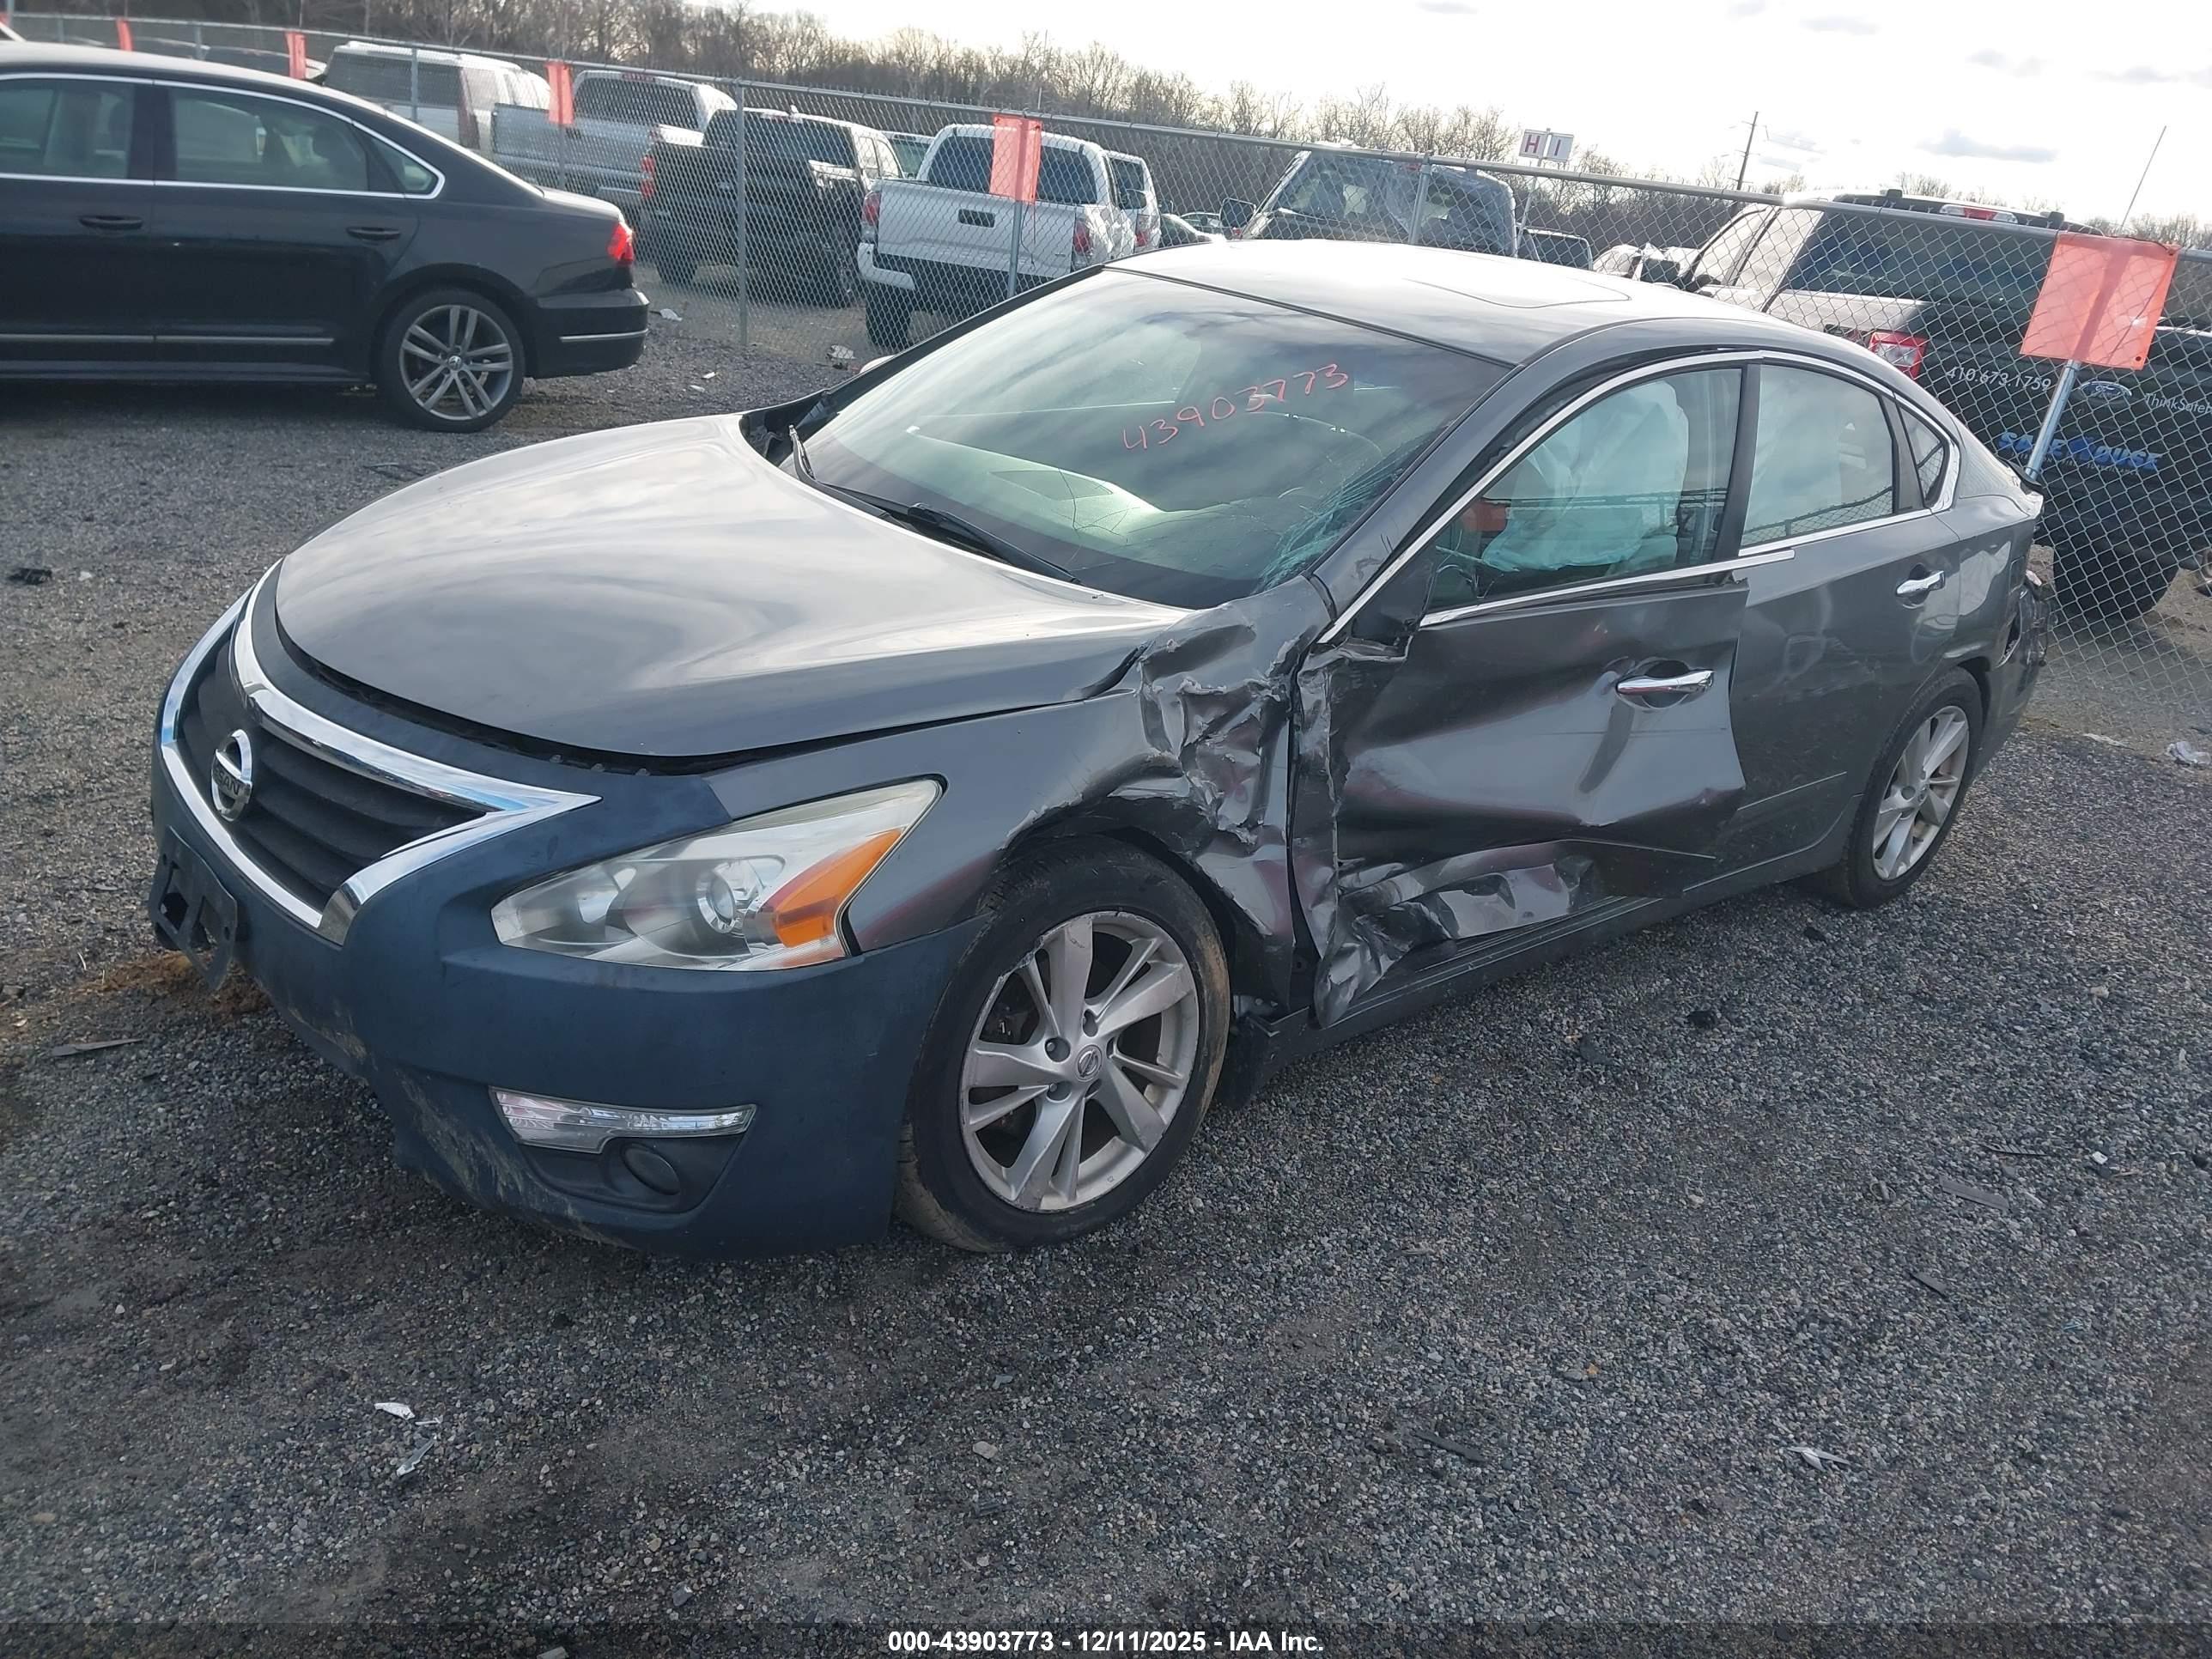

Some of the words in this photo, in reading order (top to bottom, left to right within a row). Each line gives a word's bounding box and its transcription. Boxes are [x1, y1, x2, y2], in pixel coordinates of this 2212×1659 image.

[1524, 135, 1540, 154] H
[1945, 367, 2051, 391] 410.673.1759
[1122, 363, 1349, 449] 43903773
